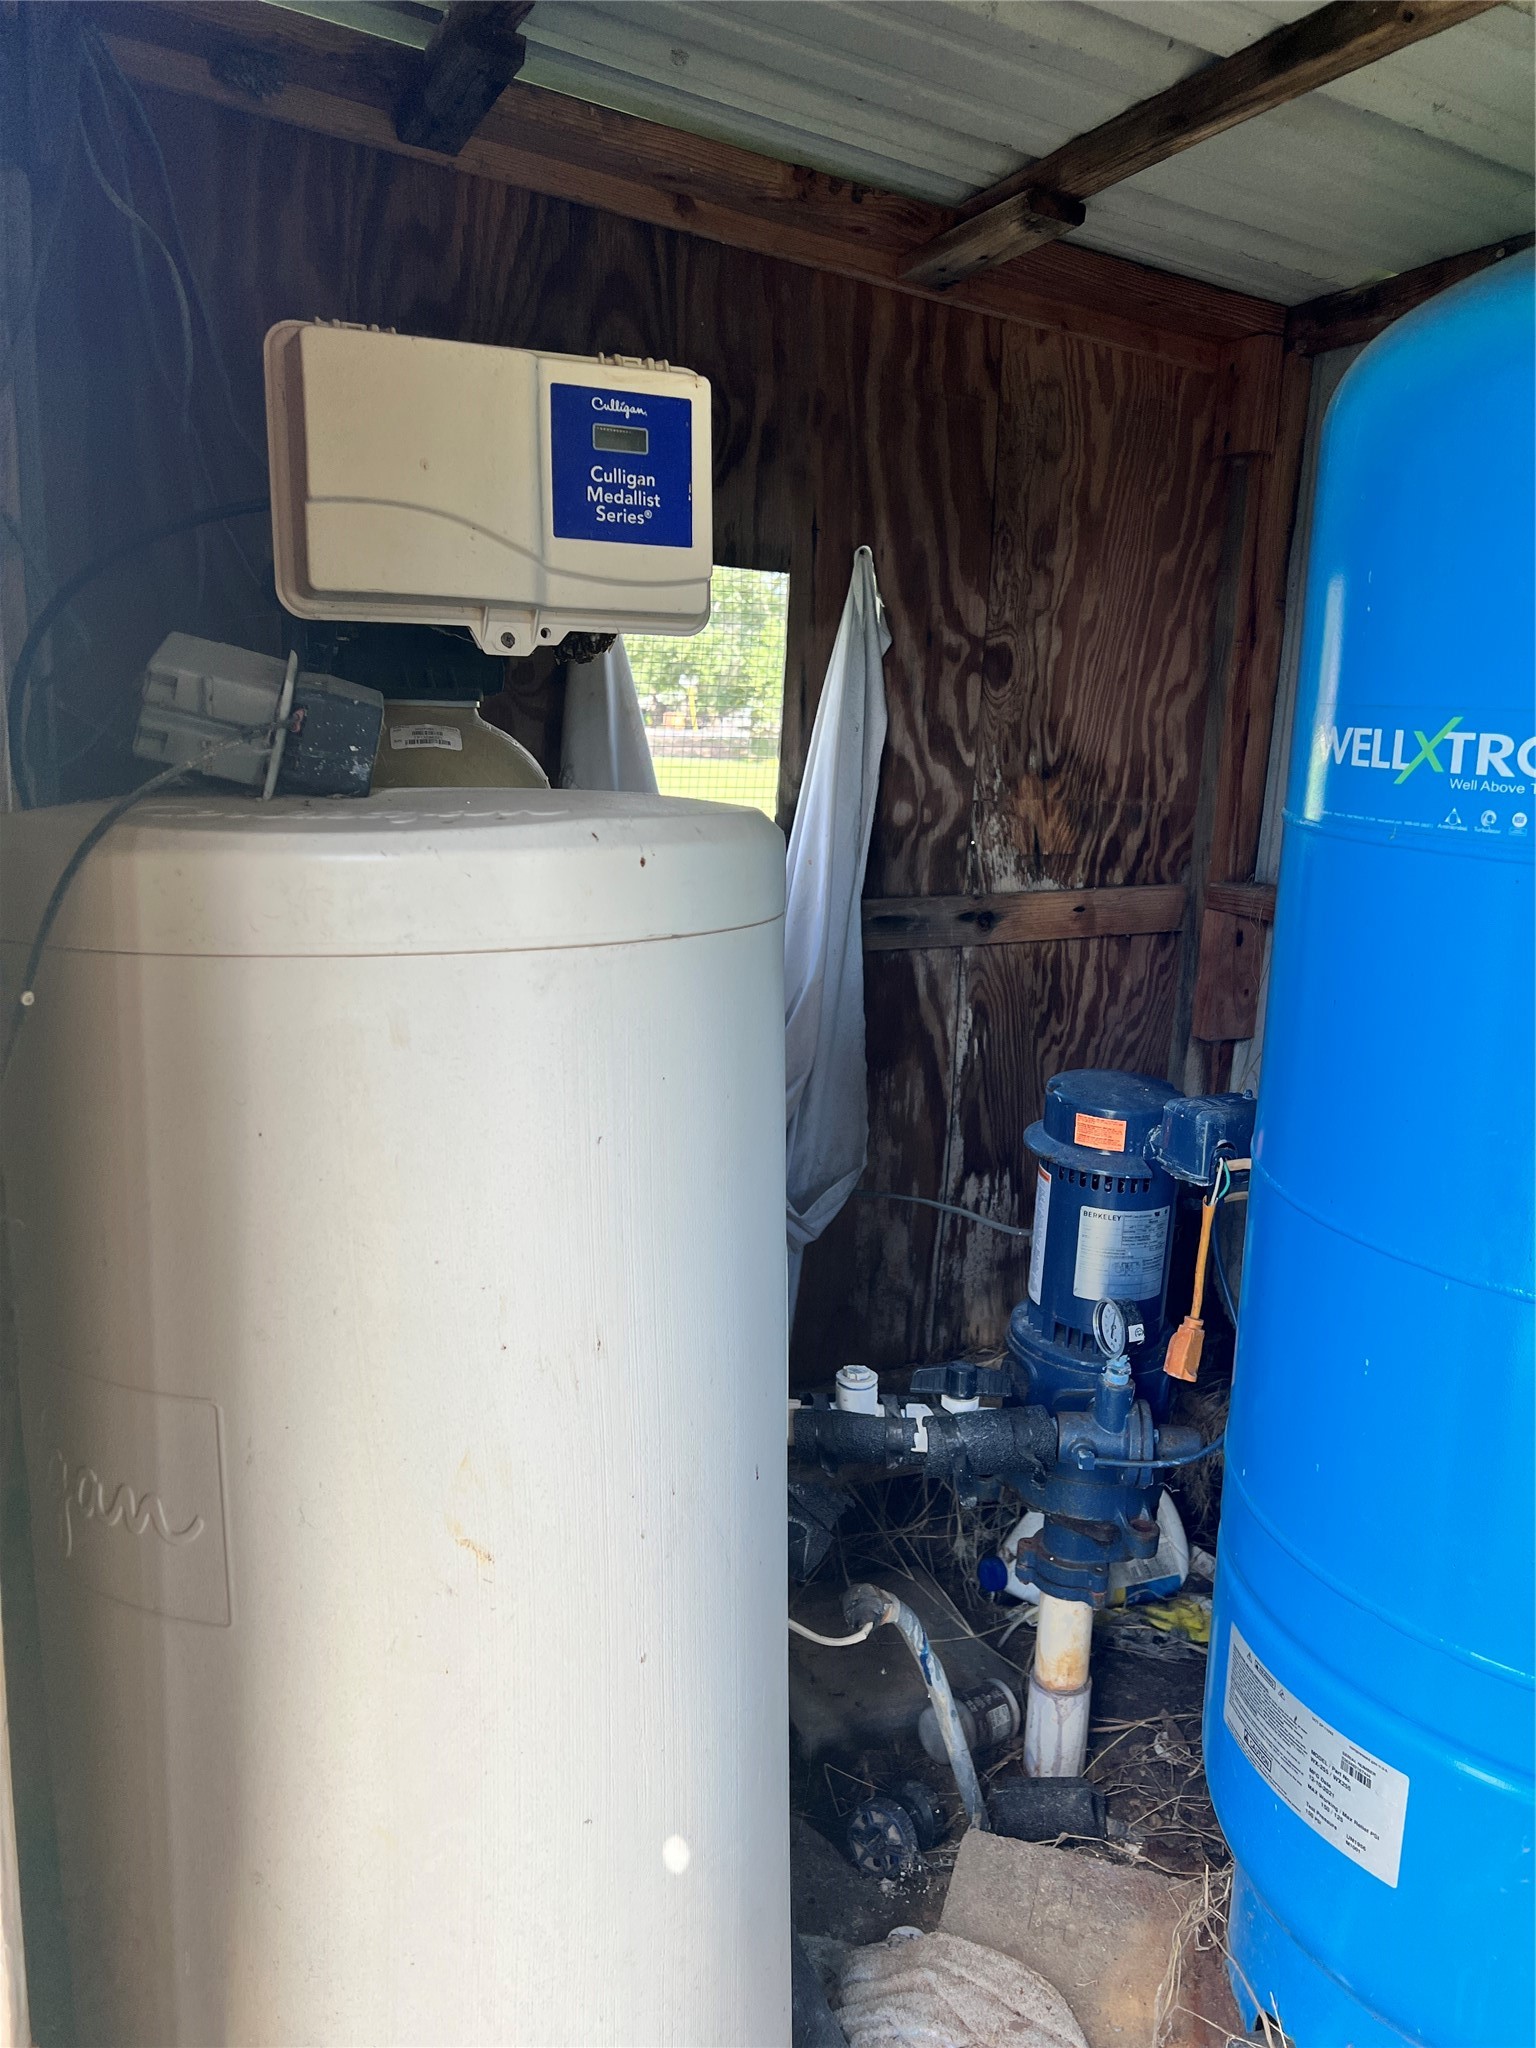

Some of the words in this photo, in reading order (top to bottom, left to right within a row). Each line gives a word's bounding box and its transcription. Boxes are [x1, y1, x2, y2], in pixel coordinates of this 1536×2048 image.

[591, 397, 646, 419] Culligan
[590, 465, 656, 489] Culligan
[587, 486, 661, 507] Medallist
[1450, 778, 1478, 791] Well
[1480, 780, 1526, 794] Above
[1083, 1210, 1122, 1222] BERKELEY
